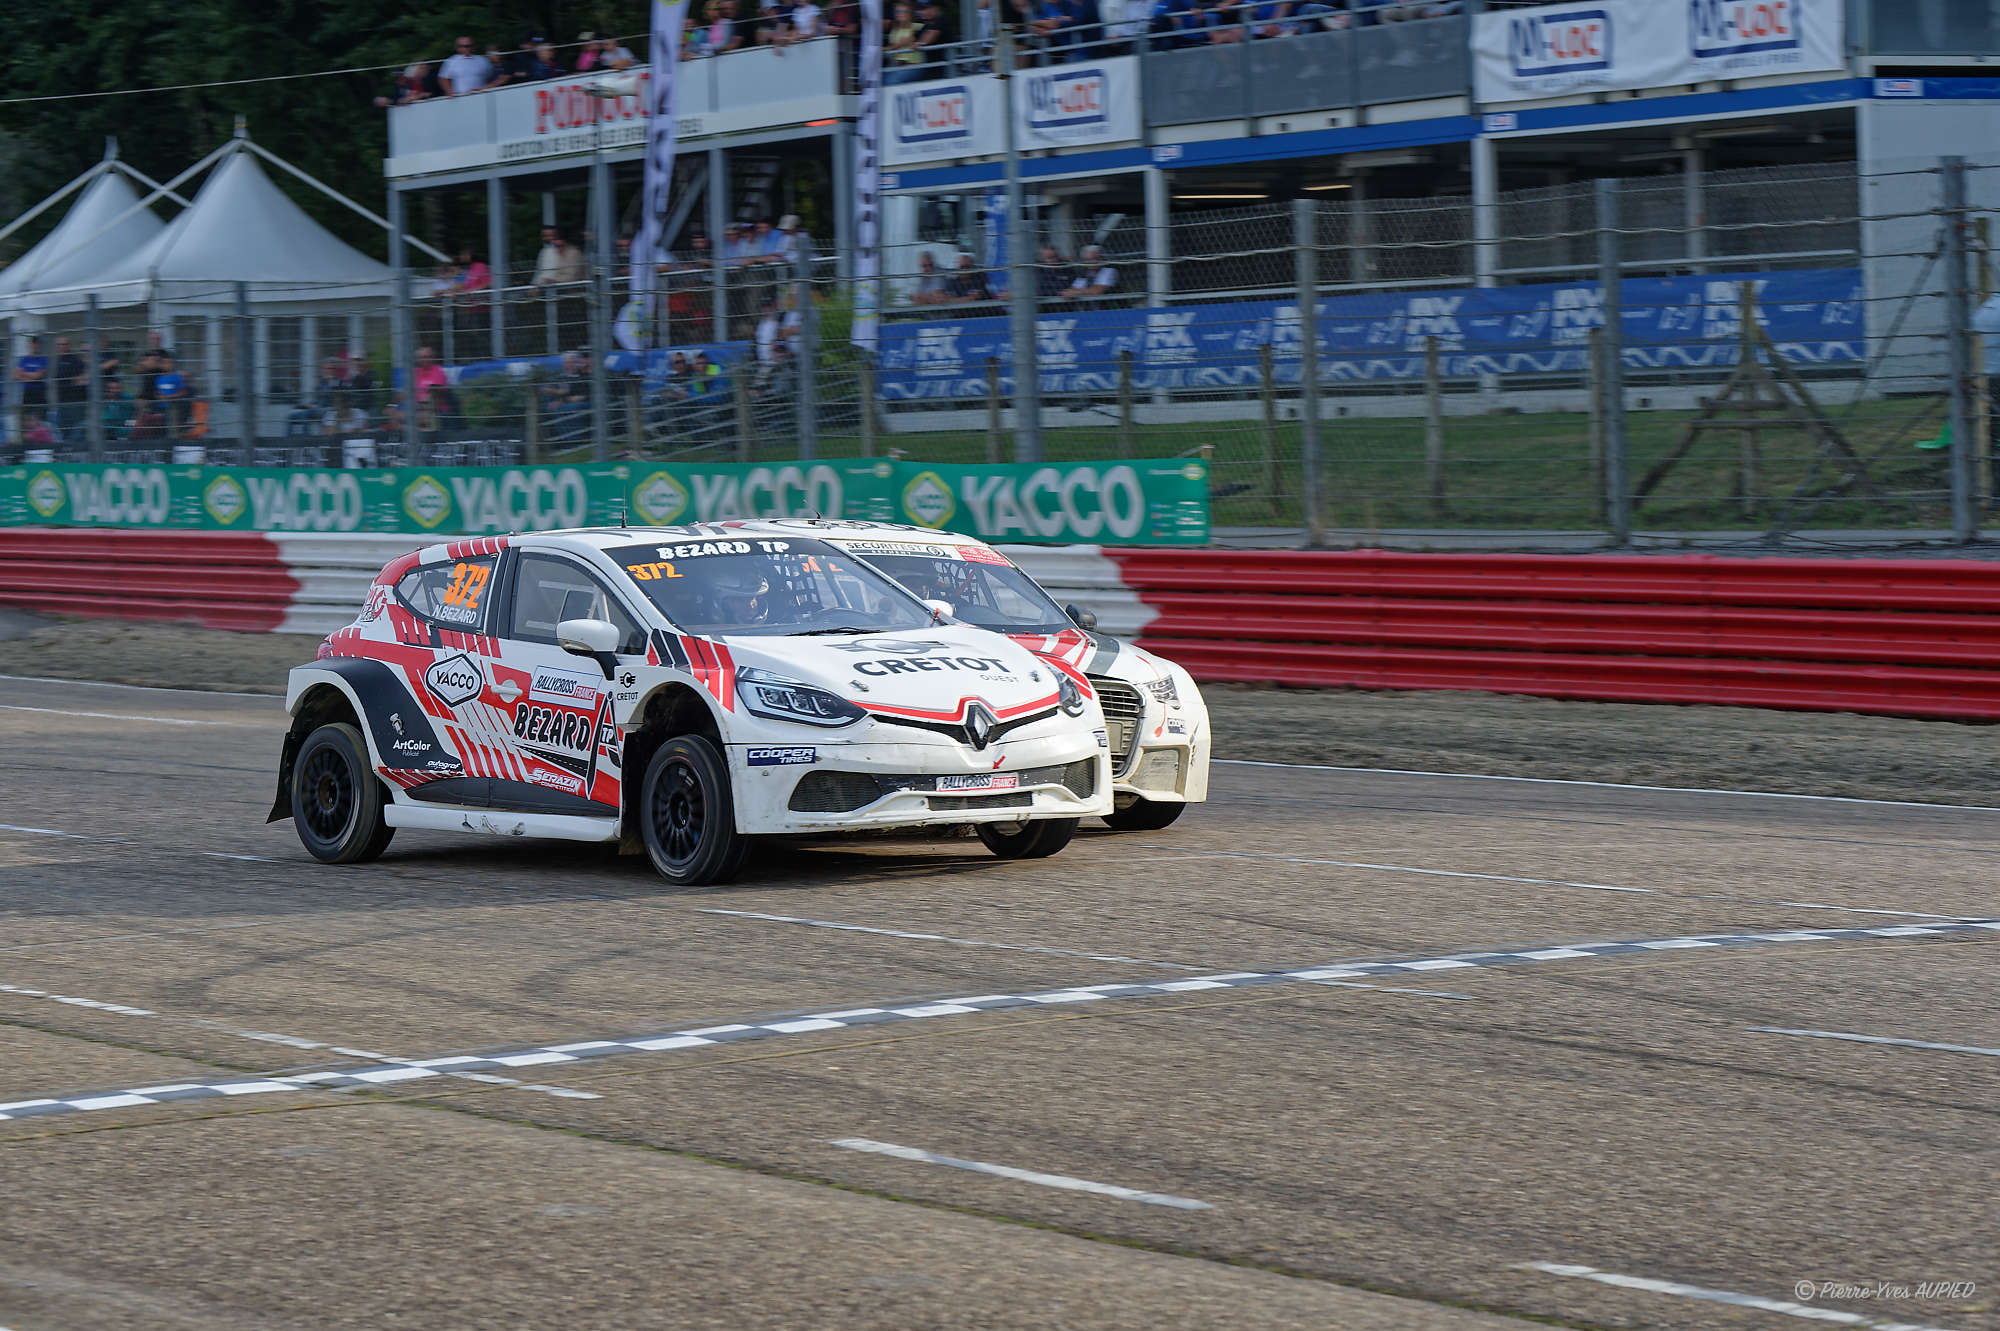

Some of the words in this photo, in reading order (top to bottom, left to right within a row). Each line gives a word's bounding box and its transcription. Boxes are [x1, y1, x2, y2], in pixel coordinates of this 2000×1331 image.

[64, 468, 171, 523] YACCO
[245, 473, 363, 531] YACCO
[451, 468, 588, 531] YACCO
[690, 465, 843, 521] YACCO
[960, 466, 1146, 538] YACCO
[656, 541, 751, 560] BEZARD
[757, 541, 790, 553] TP
[846, 541, 923, 553] SECURITEST
[627, 561, 684, 581] 372
[444, 562, 490, 609] 372
[442, 606, 477, 624] BEZARD
[852, 656, 1011, 677] CRETOT
[436, 670, 475, 690] YACCO
[534, 675, 577, 695] RALLYCROSS
[575, 686, 596, 700] FRANCE
[980, 674, 1021, 683] OUEST
[616, 692, 639, 701] CRETOT
[514, 702, 591, 752] BEZARD
[601, 727, 614, 743] TP
[393, 739, 431, 751] ArtColor
[748, 748, 814, 759] COOPER
[779, 755, 813, 764] TIRES
[941, 774, 993, 790] RALLYCROSS
[991, 778, 1017, 789] FRANCE
